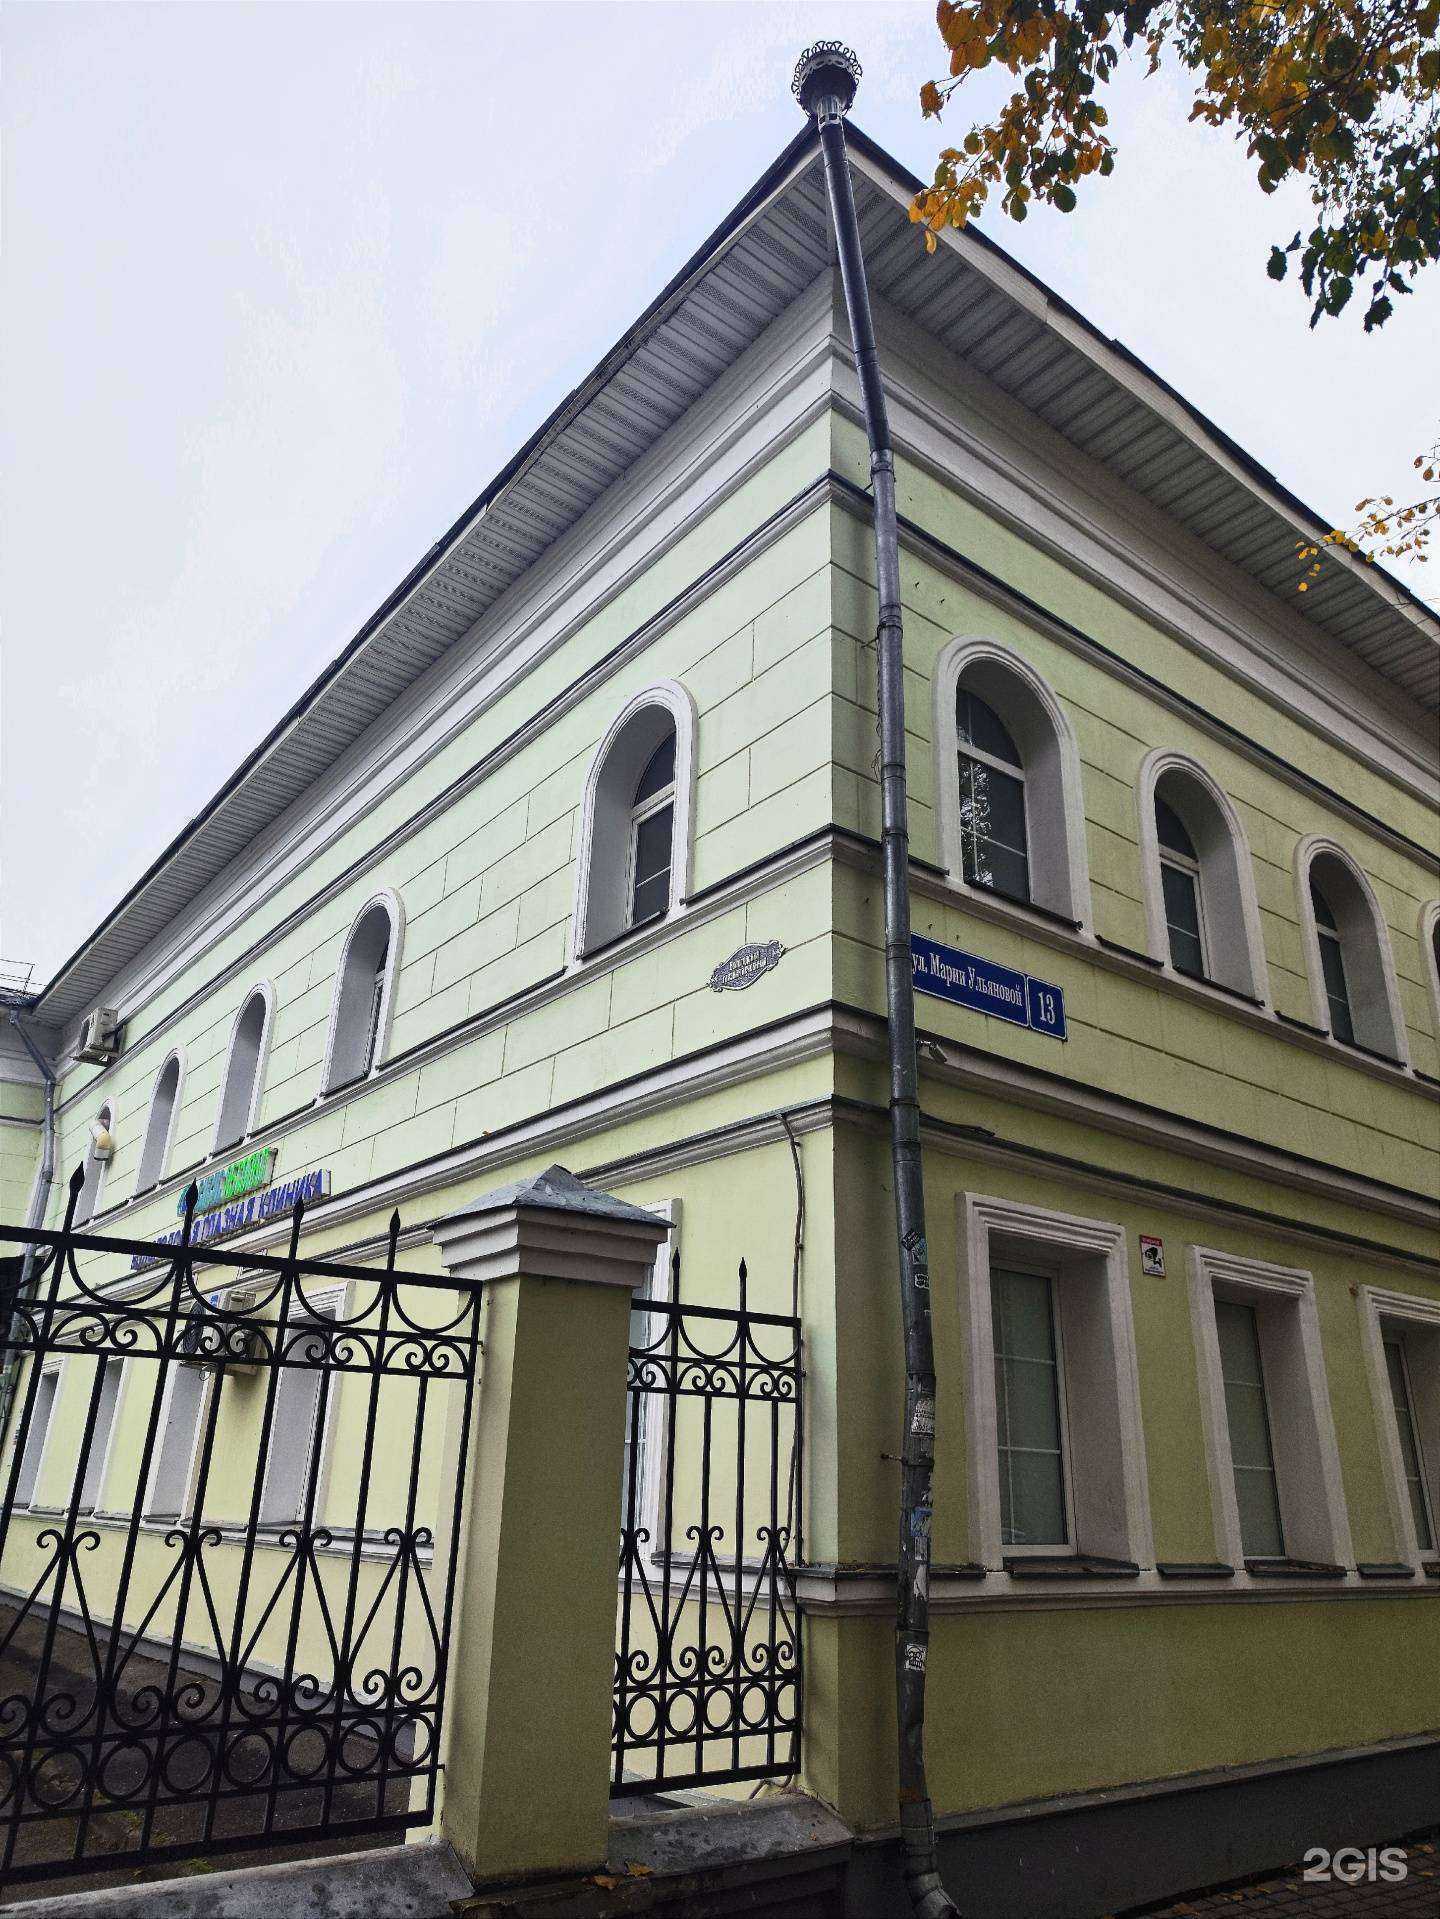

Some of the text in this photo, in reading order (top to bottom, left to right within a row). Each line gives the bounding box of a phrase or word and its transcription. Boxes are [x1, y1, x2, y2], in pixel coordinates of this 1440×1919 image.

[911, 952, 1023, 1007] ул. Марии Ульяновой
[1037, 991, 1056, 1025] 13
